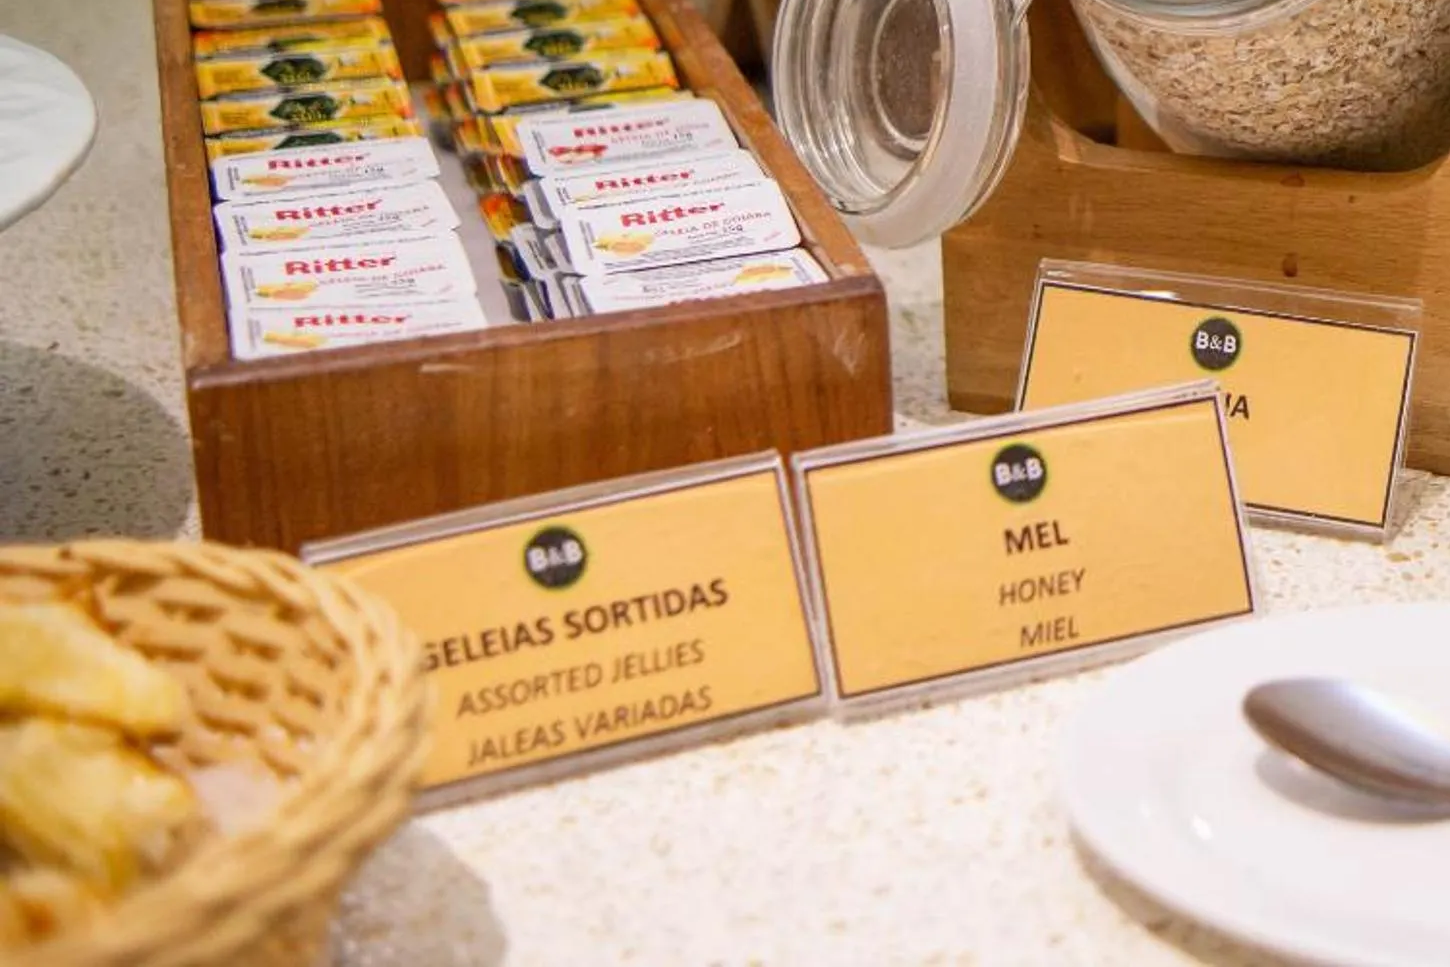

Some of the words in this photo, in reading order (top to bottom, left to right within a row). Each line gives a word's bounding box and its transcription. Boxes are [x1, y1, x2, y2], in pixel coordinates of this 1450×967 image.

[573, 118, 669, 138] Ritter
[268, 153, 370, 171] Ritter
[595, 169, 695, 191] Ritter
[275, 197, 382, 222] Ritter
[620, 202, 725, 228] Ritter
[284, 254, 396, 276] Ritter
[293, 314, 411, 329] Ritter
[1195, 330, 1237, 354] B&B
[994, 456, 1043, 487] B&B
[1003, 519, 1071, 555] MEL
[526, 538, 583, 574] B&B
[999, 568, 1086, 607] HONEY
[563, 578, 729, 640] SORTIDAS
[1020, 617, 1080, 649] MIEL
[456, 662, 604, 720] ASSORTED
[612, 638, 706, 685] JELLIES
[466, 718, 566, 768] JALEAS
[574, 684, 714, 741] VARIADAS
